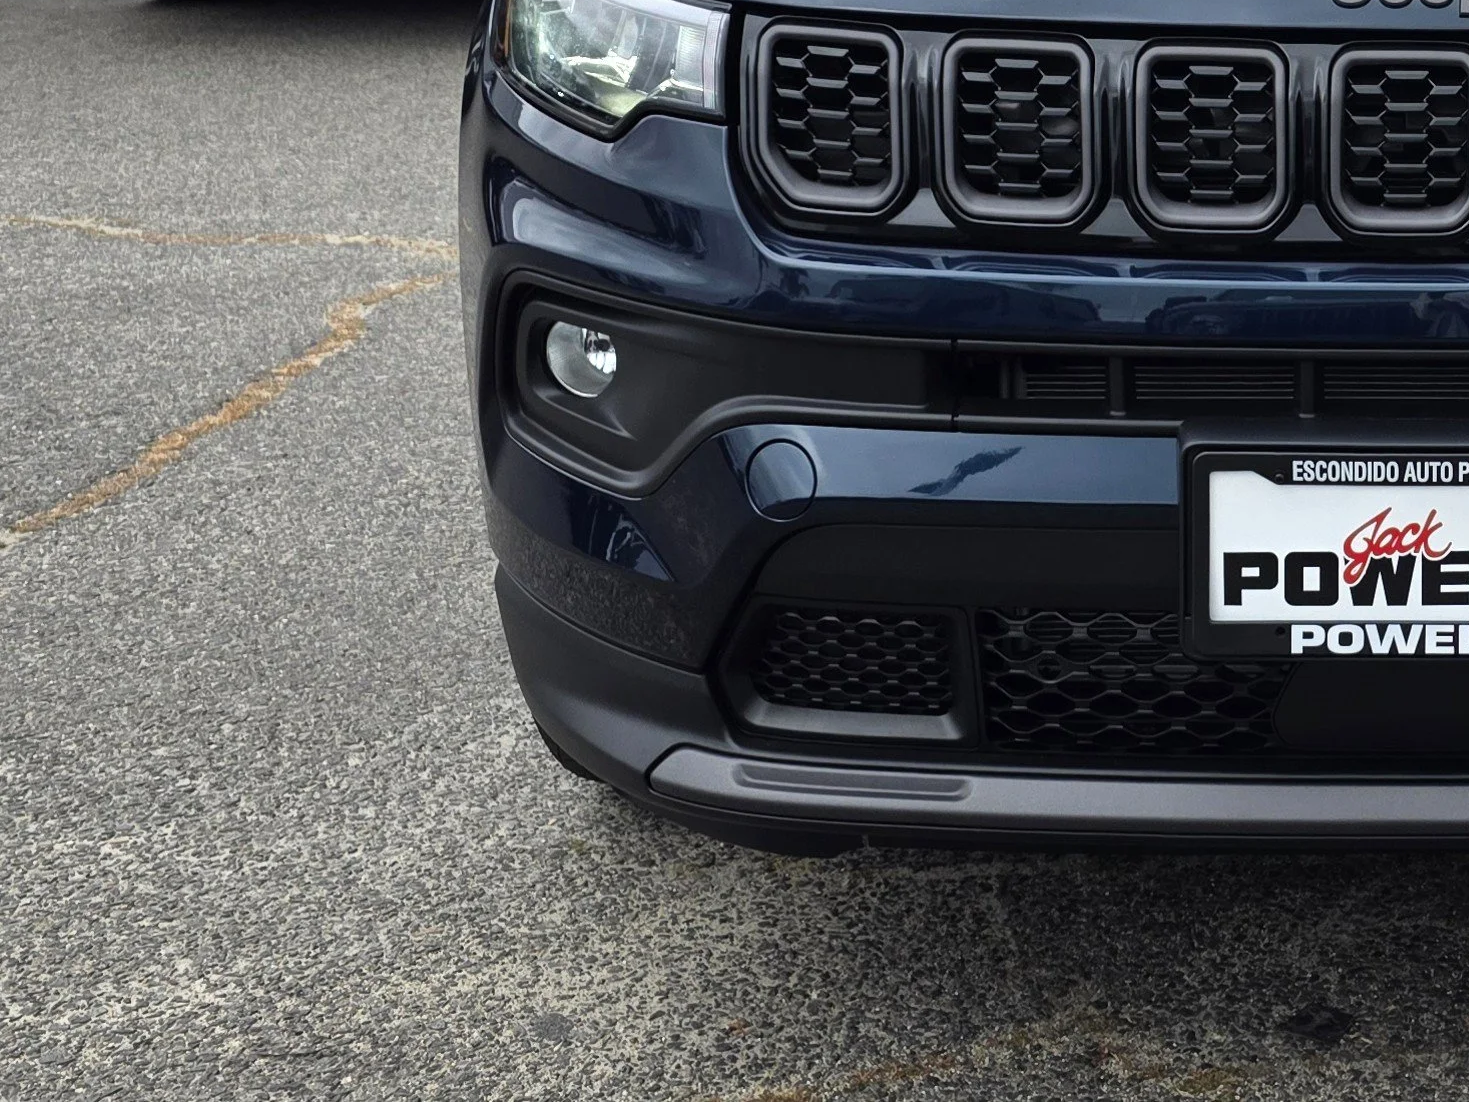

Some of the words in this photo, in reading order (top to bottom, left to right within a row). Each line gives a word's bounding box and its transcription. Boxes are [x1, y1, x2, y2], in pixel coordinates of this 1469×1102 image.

[1292, 460, 1399, 482] ESCONDIDO
[1403, 461, 1454, 483] AUTO
[1343, 506, 1452, 585] Jack
